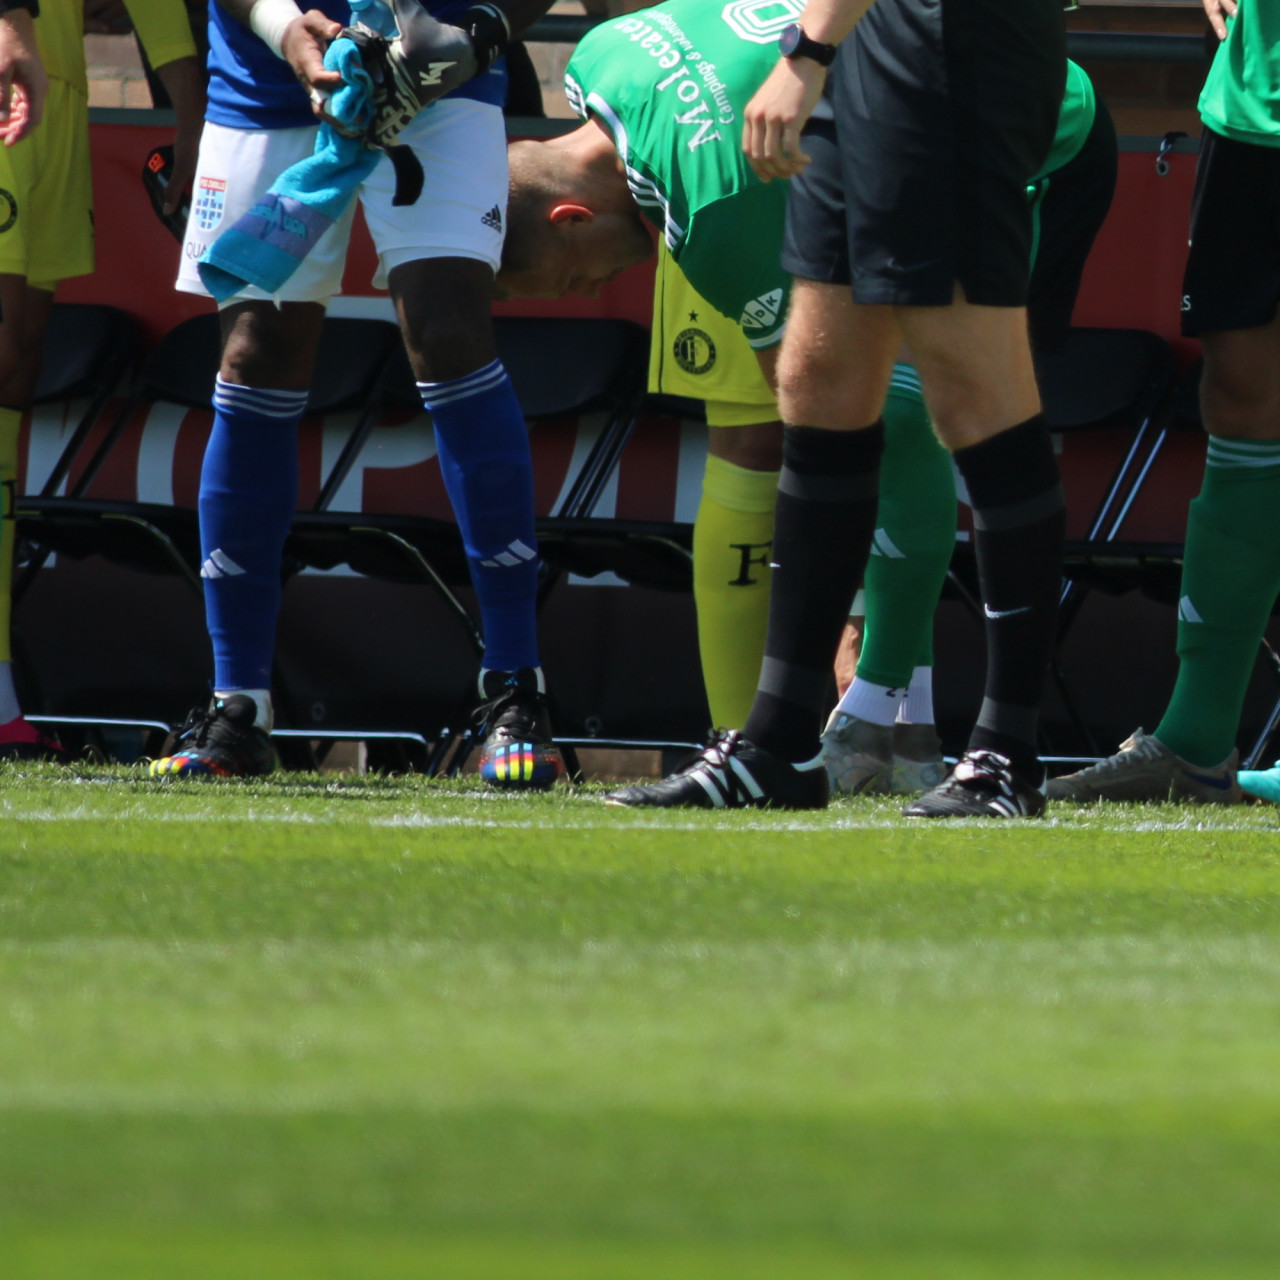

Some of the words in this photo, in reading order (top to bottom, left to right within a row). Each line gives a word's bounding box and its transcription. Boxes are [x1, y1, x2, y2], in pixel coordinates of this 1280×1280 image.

[685, 51, 702, 61] &
[695, 60, 735, 125] Campings
[727, 541, 771, 587] F
